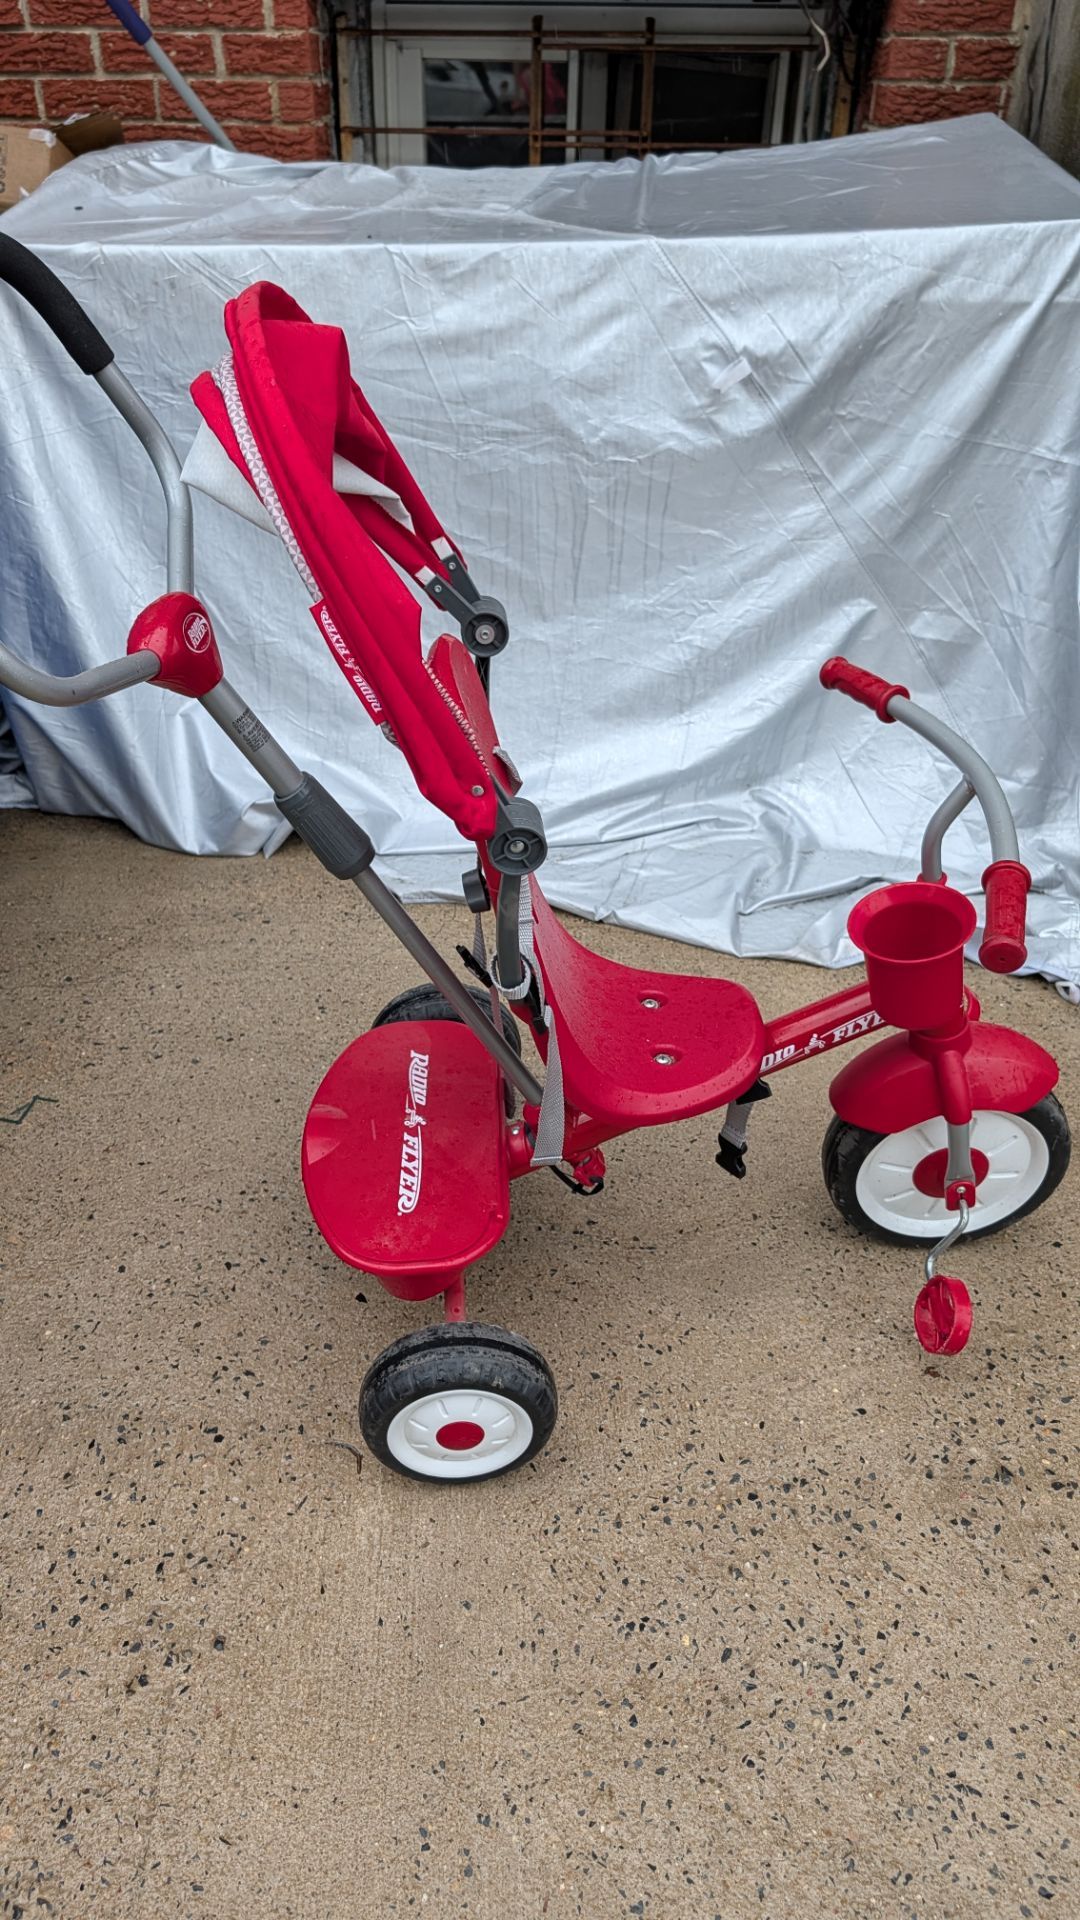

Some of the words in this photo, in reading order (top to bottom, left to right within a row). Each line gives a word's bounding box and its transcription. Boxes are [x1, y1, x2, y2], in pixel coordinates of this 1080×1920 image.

[320, 605, 351, 659] FLYER
[352, 674, 382, 713] RADIO
[409, 1050, 429, 1107] RADIO
[760, 1043, 796, 1073] DIO
[398, 1129, 422, 1214] FLYER
